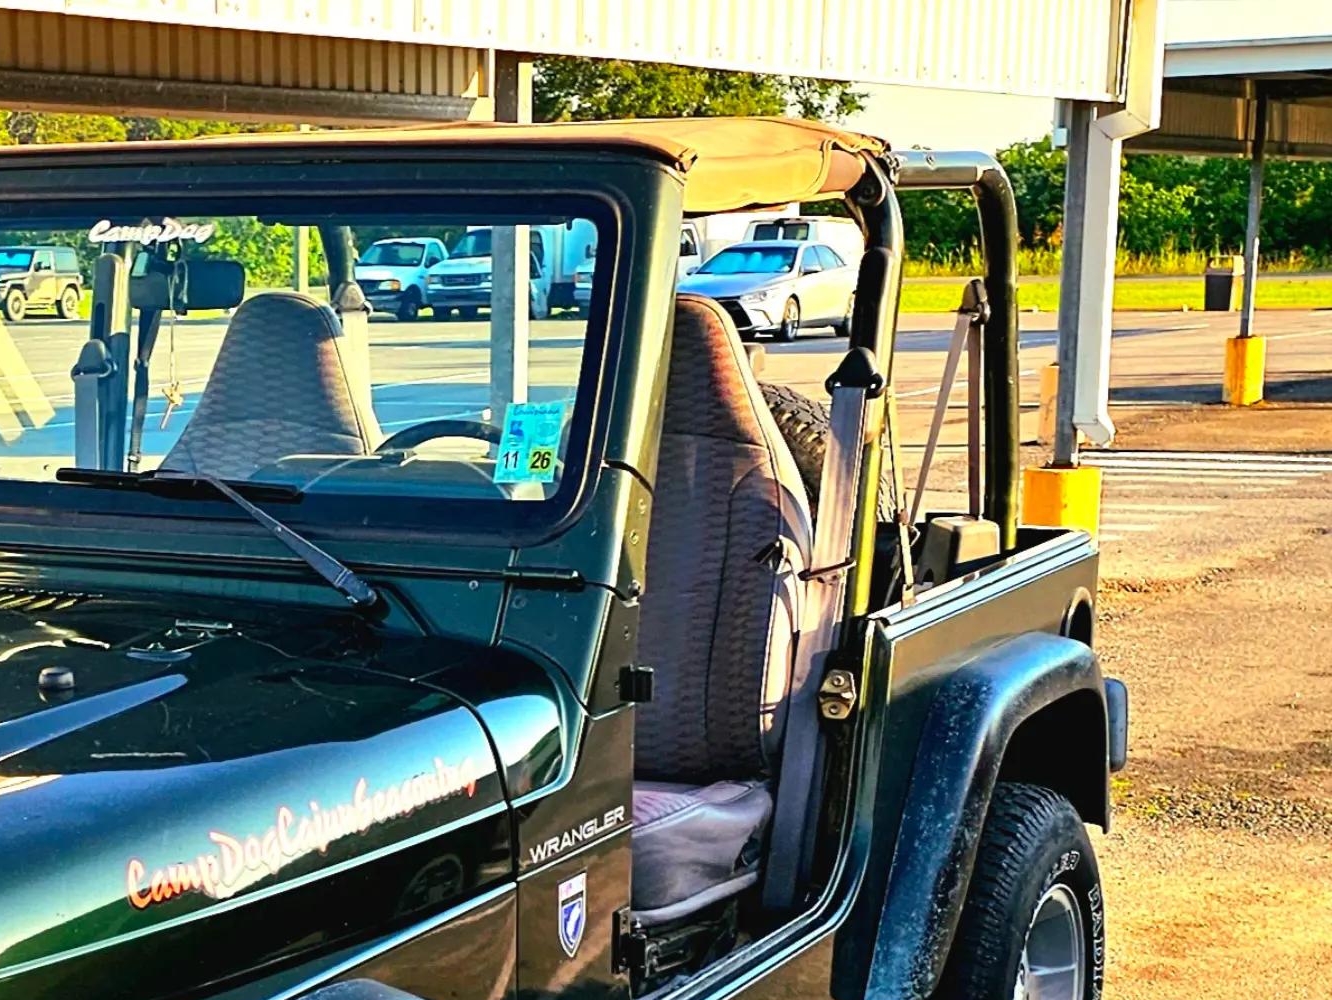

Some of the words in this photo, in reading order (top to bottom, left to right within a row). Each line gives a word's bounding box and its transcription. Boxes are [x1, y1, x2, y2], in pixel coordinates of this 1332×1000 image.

[502, 451, 519, 470] 11
[530, 450, 552, 470] 26
[529, 805, 626, 864] WRANGLER
